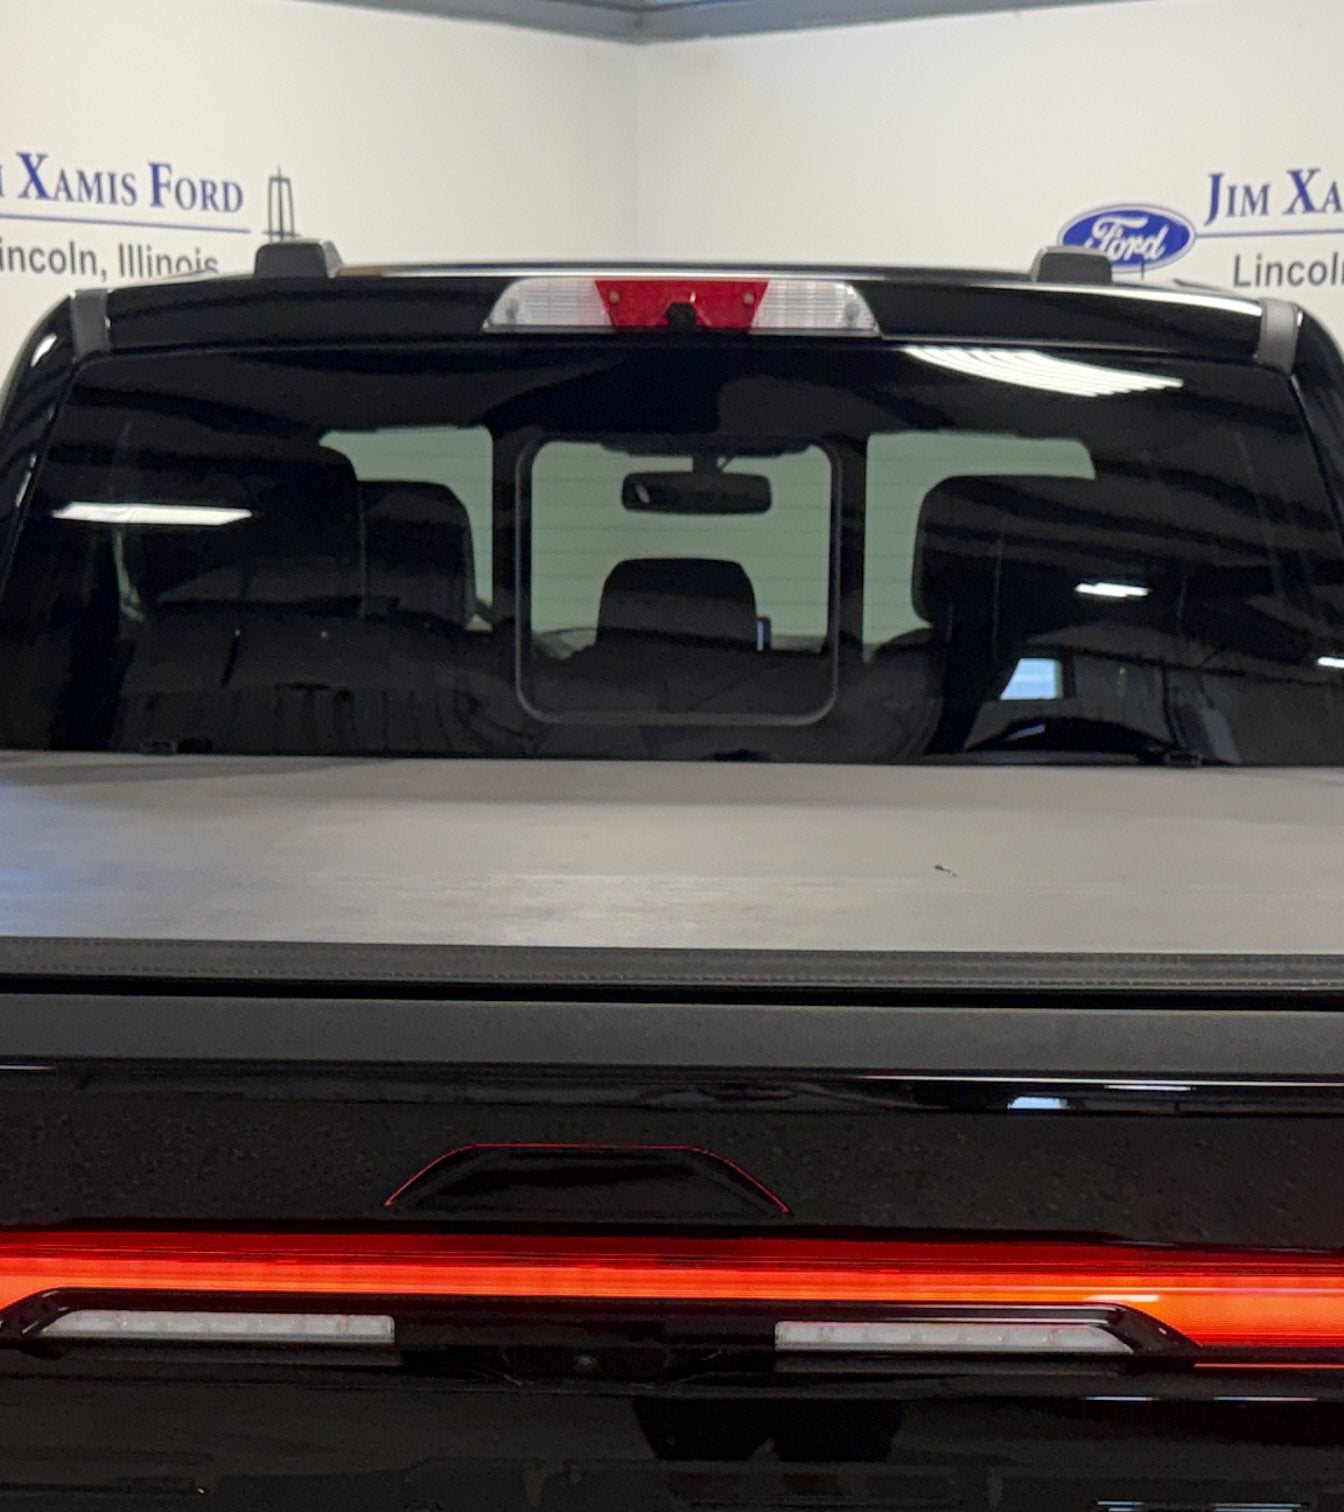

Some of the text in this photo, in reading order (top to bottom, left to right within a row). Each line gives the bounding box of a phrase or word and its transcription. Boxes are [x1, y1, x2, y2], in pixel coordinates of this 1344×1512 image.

[16, 150, 138, 208] XAMIS
[147, 160, 244, 213] FORD
[1203, 172, 1271, 227] JIM
[118, 241, 220, 278] Illinois
